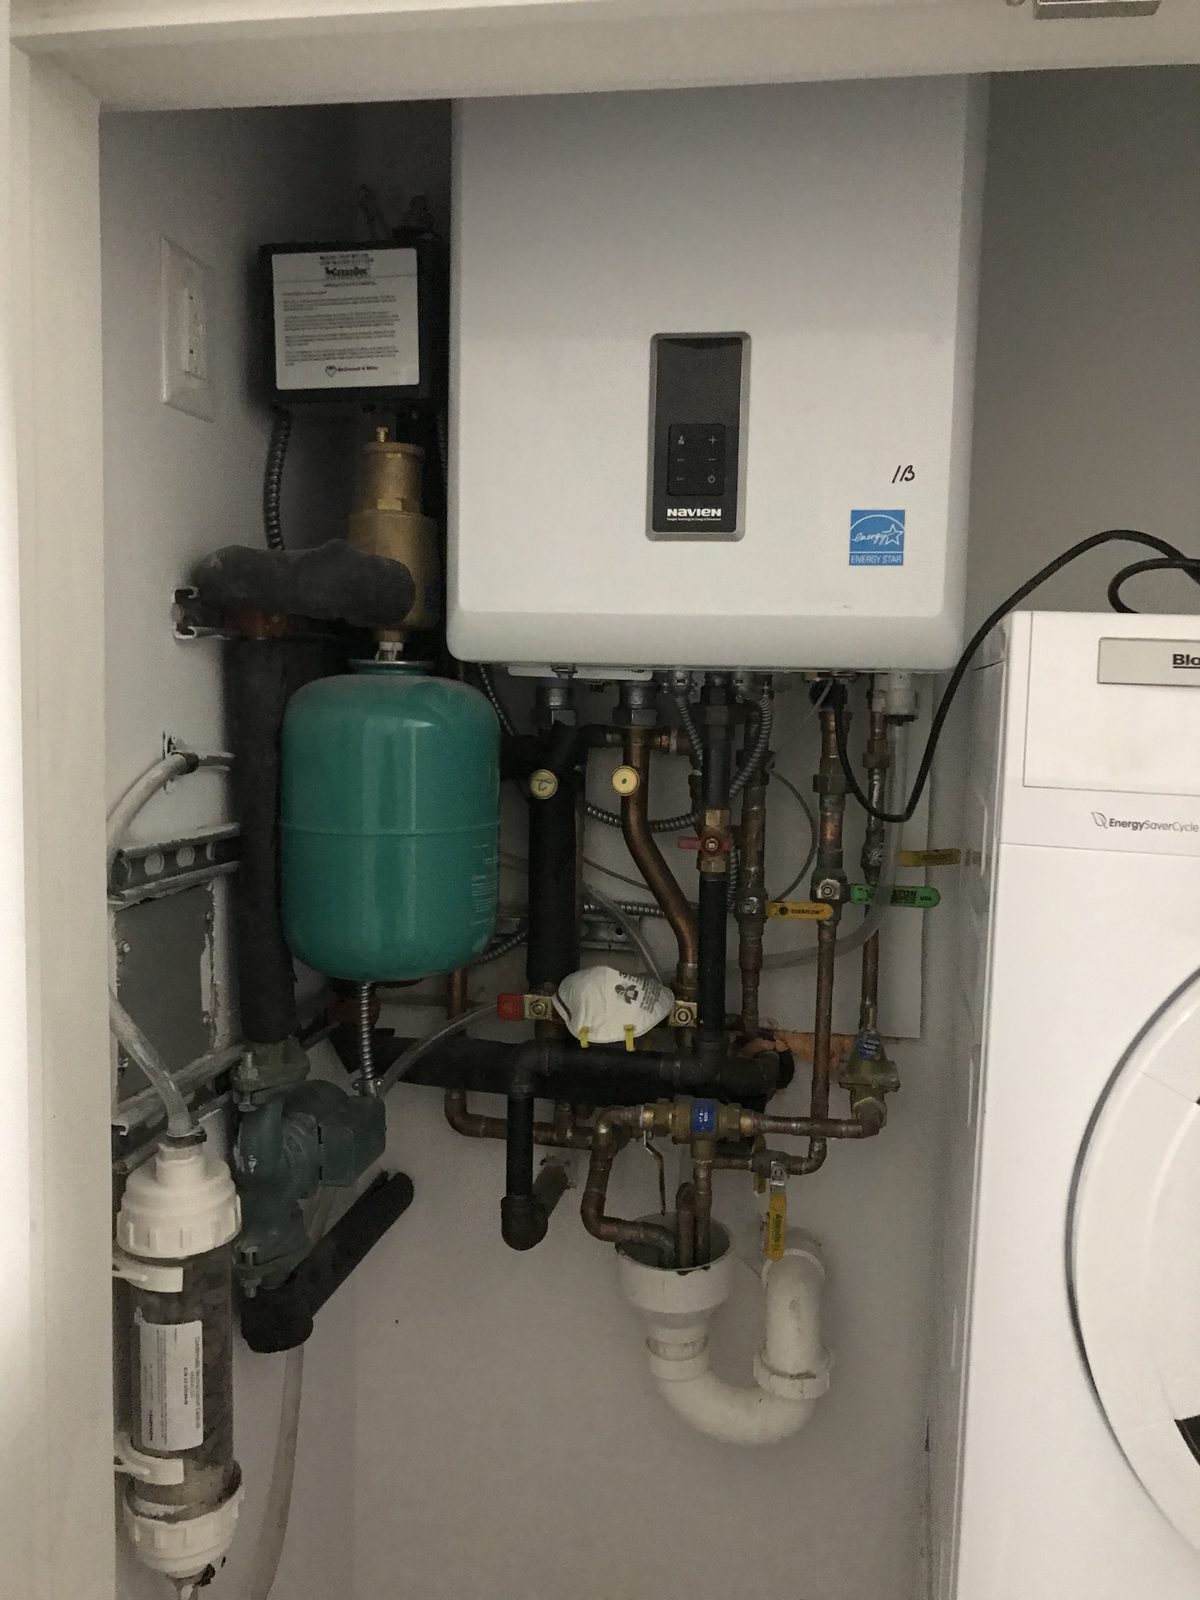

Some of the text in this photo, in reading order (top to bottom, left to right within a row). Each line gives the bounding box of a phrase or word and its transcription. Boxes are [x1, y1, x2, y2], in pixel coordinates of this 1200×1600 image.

[851, 554, 902, 565] ENERGY STAR
[1109, 818, 1200, 833] EnergySaverCycle
